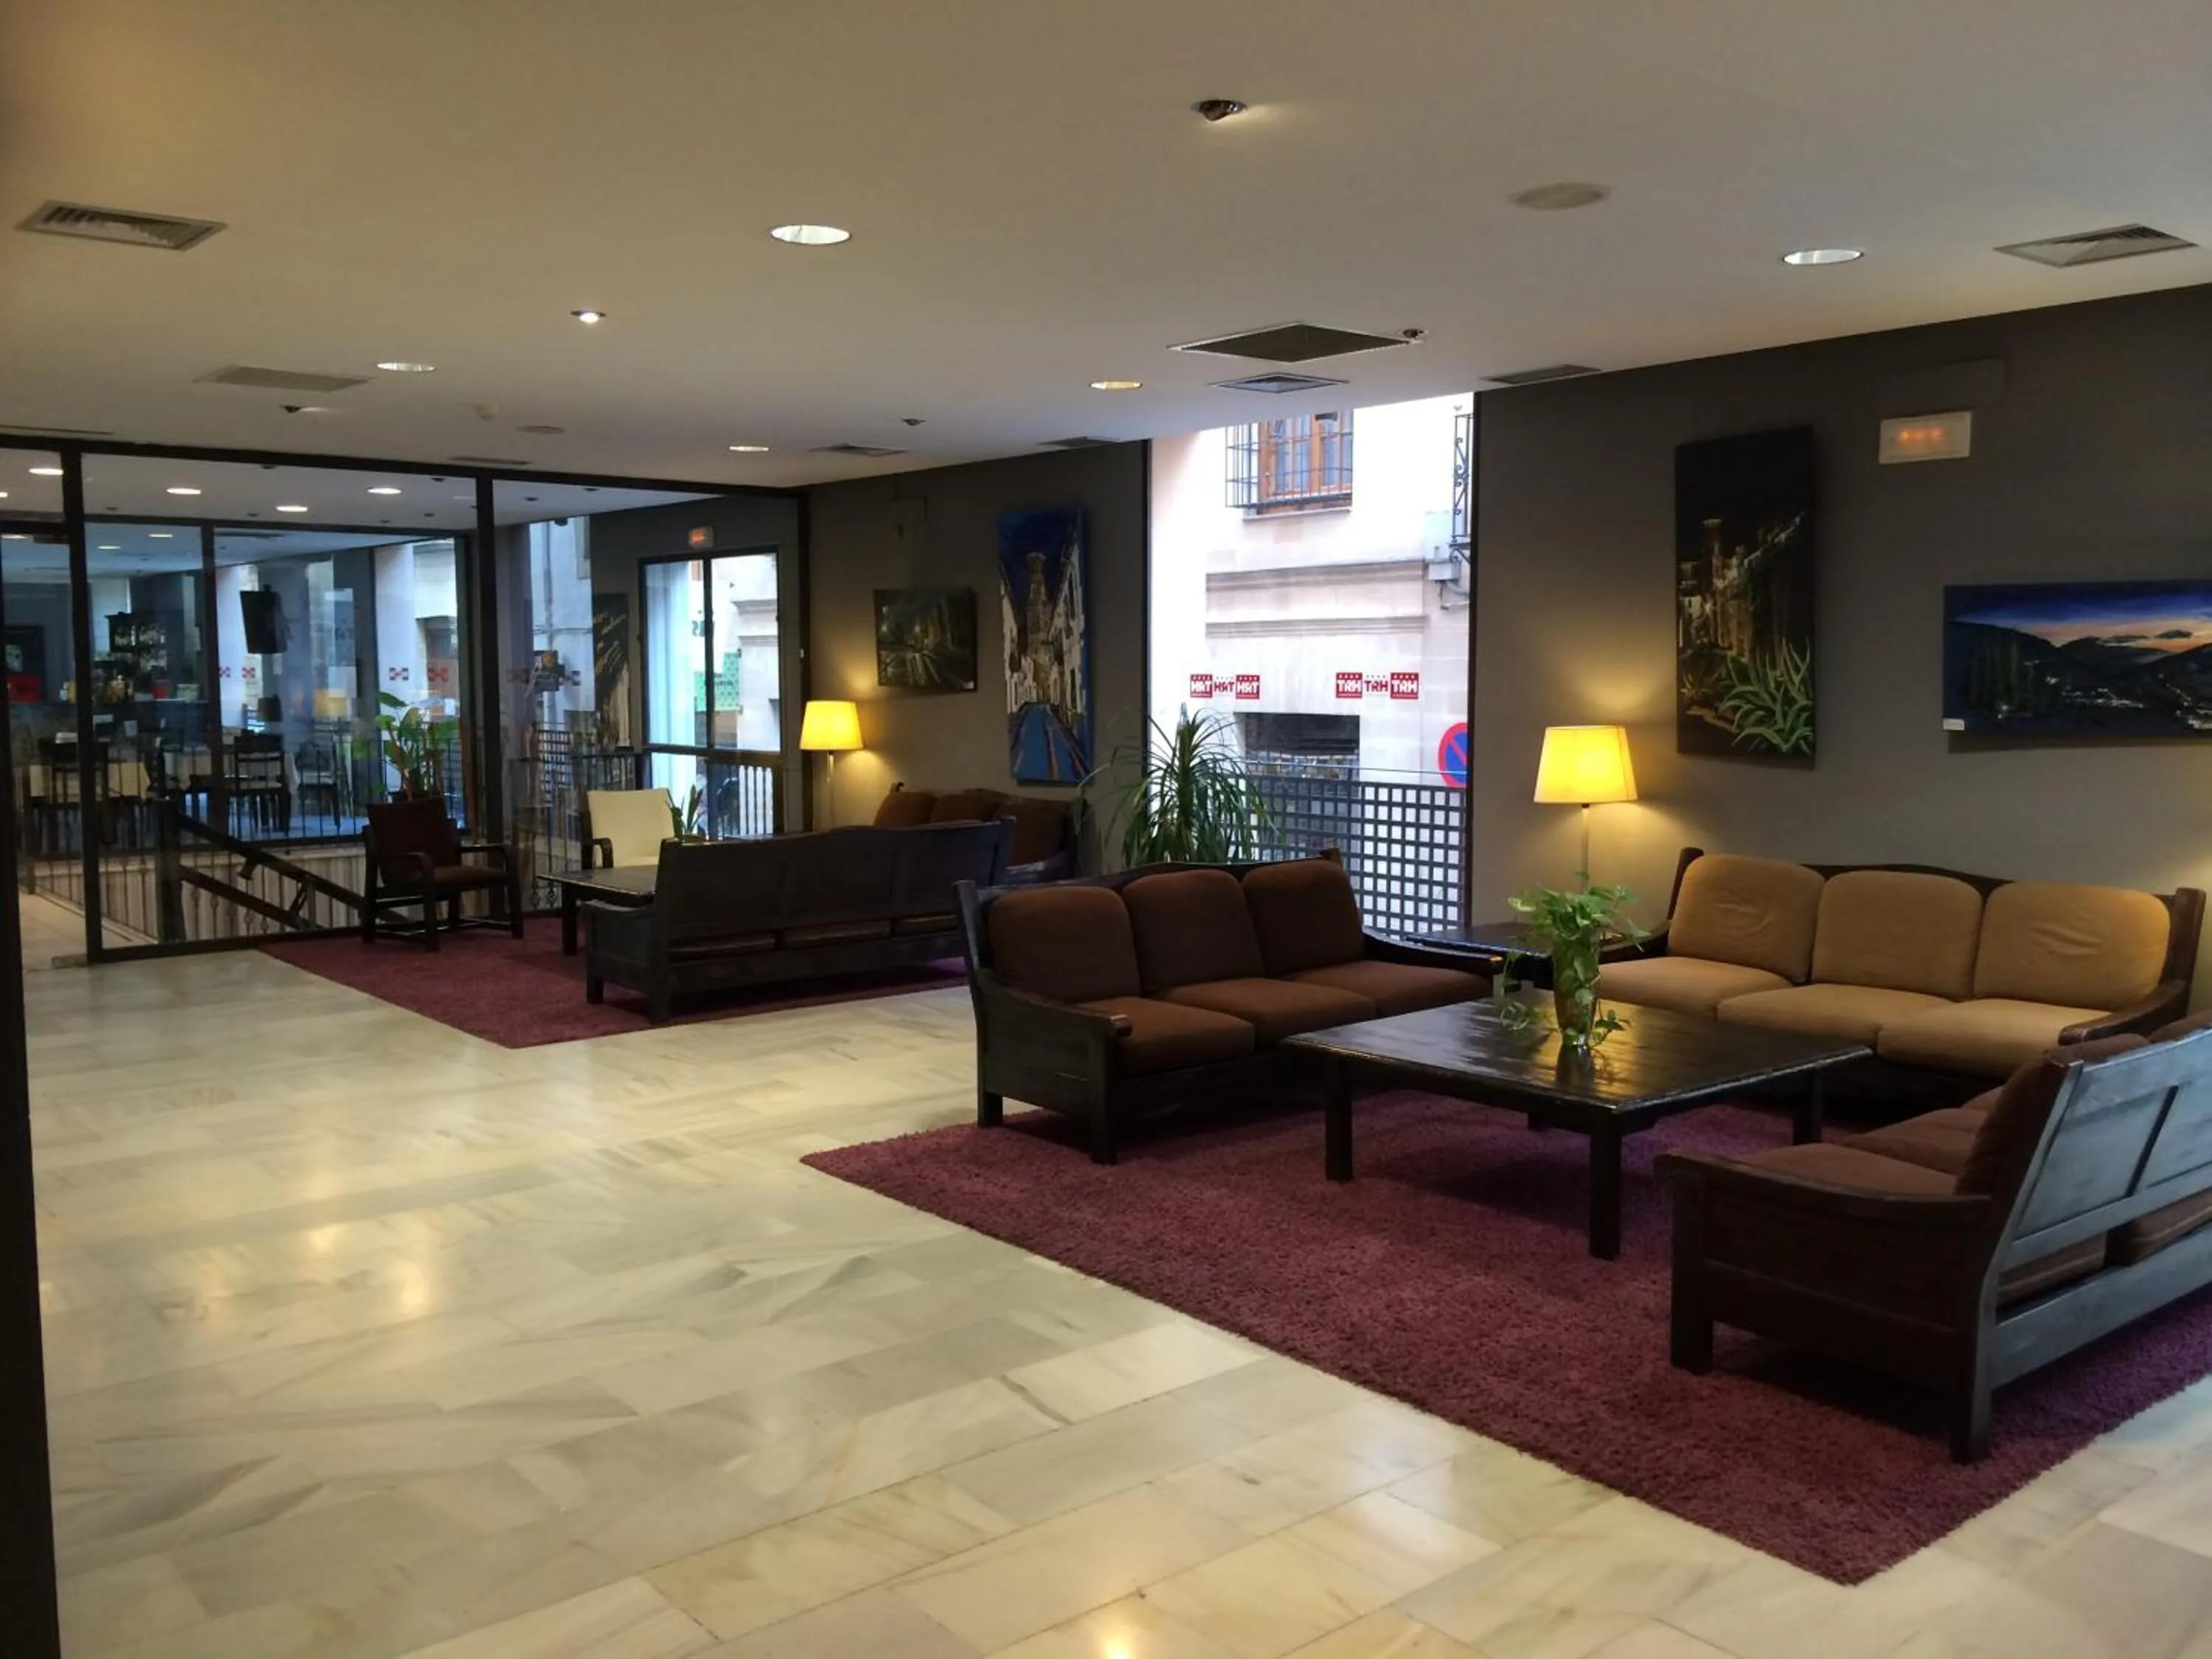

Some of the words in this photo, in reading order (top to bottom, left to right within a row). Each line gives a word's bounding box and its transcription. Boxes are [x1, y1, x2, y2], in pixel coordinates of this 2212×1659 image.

[1337, 679, 1362, 692] TRH
[1364, 680, 1388, 692] TRH
[1391, 679, 1418, 692] TRH
